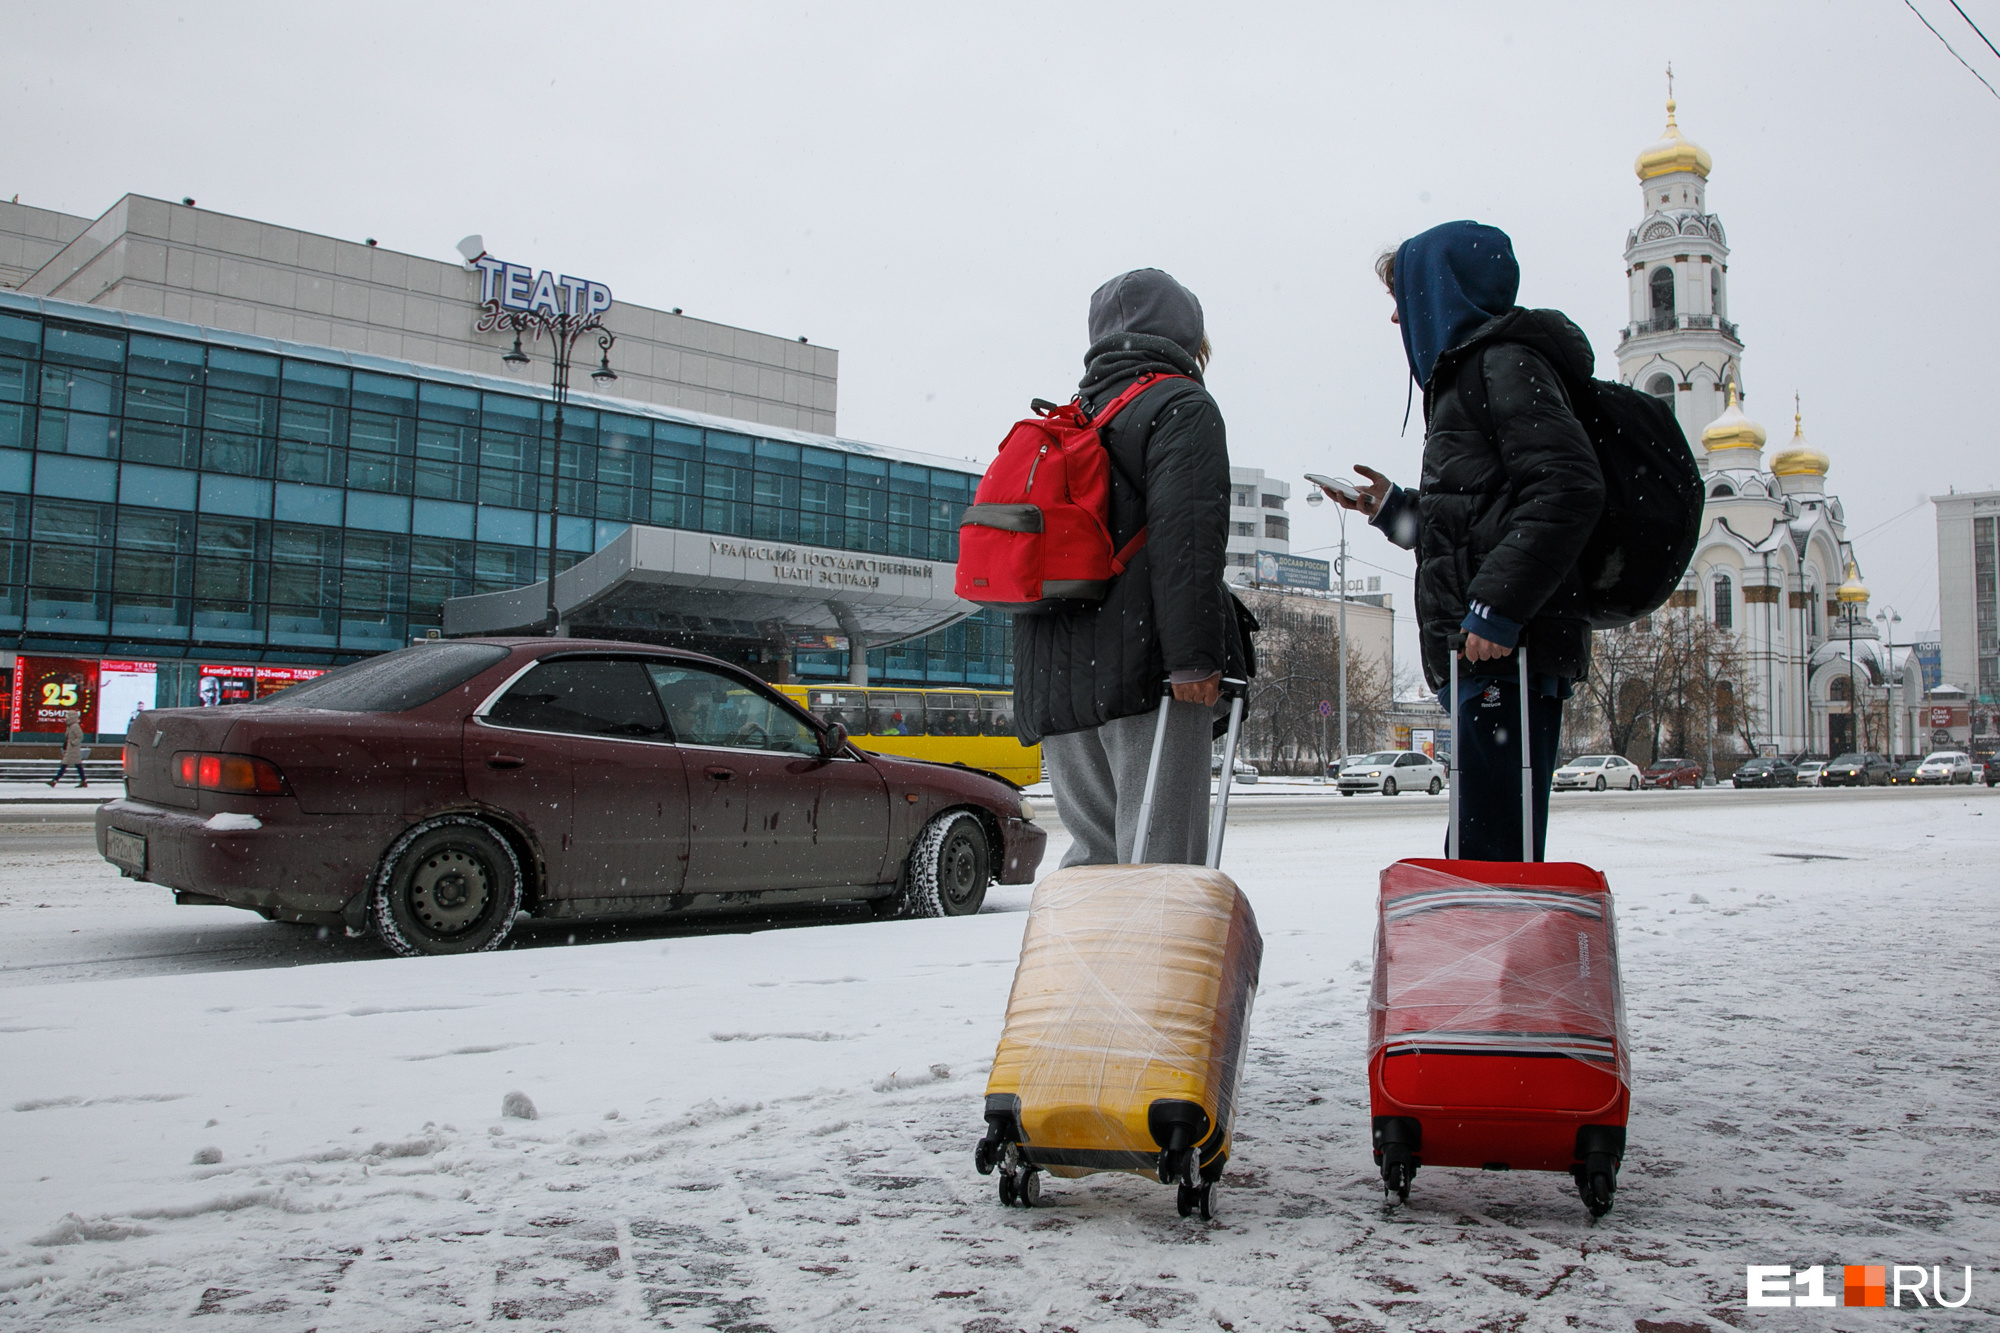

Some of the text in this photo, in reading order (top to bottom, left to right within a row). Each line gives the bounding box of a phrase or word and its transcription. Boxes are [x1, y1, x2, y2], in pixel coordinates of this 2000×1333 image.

[476, 257, 612, 317] ТЕАТР
[711, 541, 933, 578] УРАЛЬСКИЙ ГОСУДАРСТВЕННЫЙ
[1304, 561, 1328, 571] РОССИИ
[774, 564, 880, 588] ТЕАТР ЭСТРАДЫ
[42, 683, 78, 706] 25
